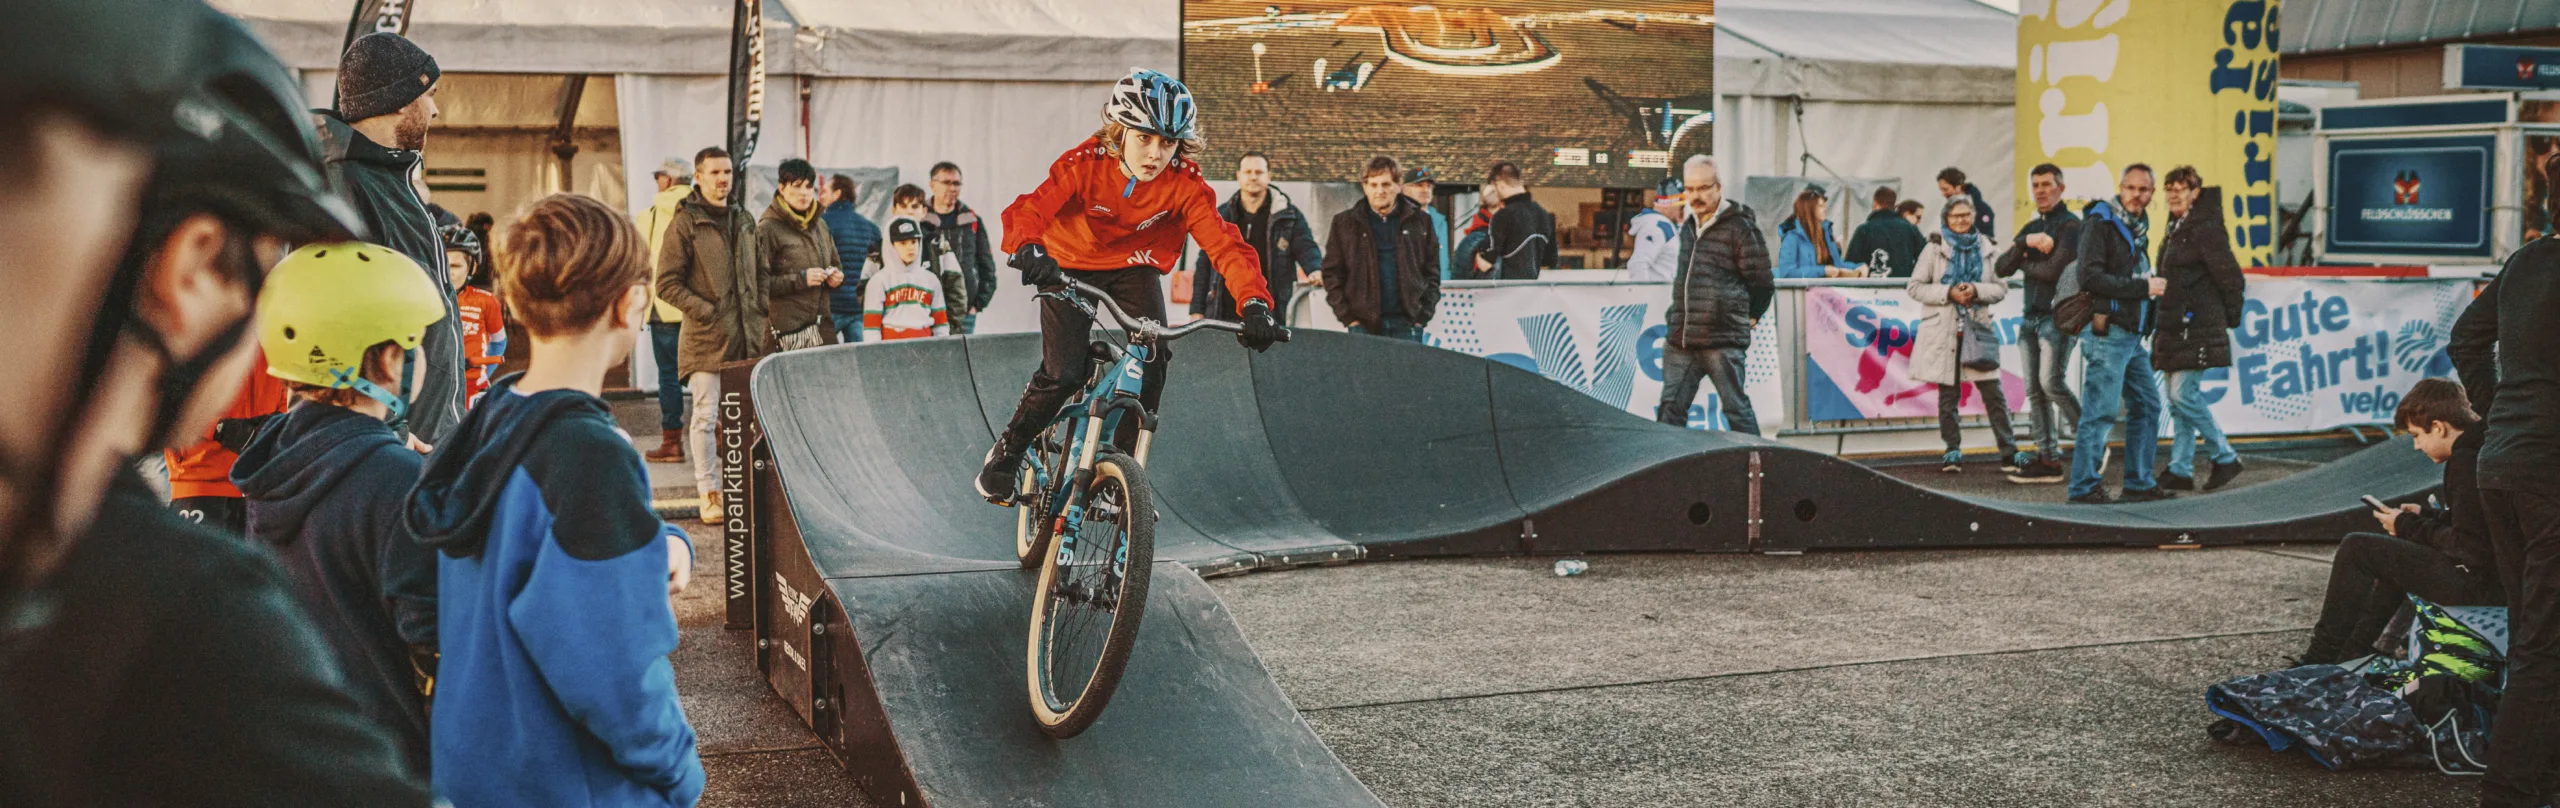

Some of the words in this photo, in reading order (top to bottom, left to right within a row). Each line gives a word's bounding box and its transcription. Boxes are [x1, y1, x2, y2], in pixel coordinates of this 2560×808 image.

[1126, 249, 1160, 265] NK
[2235, 290, 2350, 349] Gute
[2238, 330, 2390, 405] Fahrt!
[2340, 384, 2400, 414] velo
[721, 392, 748, 600] www.parkitect.ch
